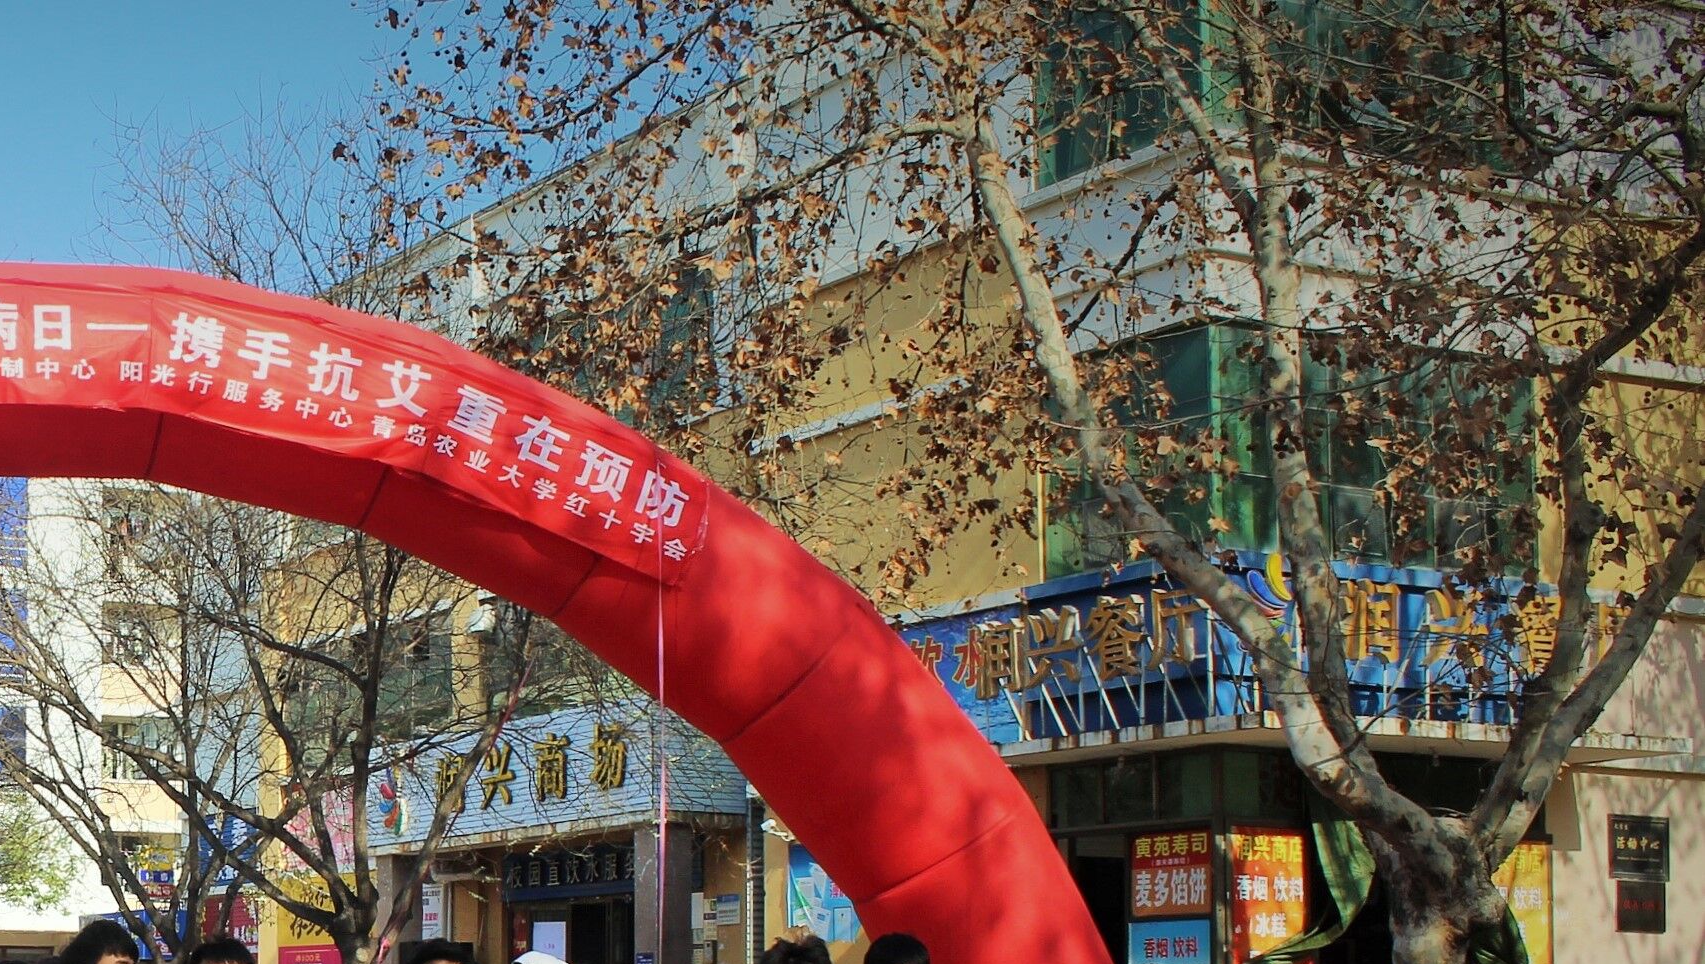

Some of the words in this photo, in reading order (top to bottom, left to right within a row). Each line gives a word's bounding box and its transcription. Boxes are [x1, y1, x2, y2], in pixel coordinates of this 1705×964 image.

[119, 360, 354, 429] 阳光行服务中心
[1236, 874, 1268, 901] 香烟
[1273, 872, 1304, 903] 饮料
